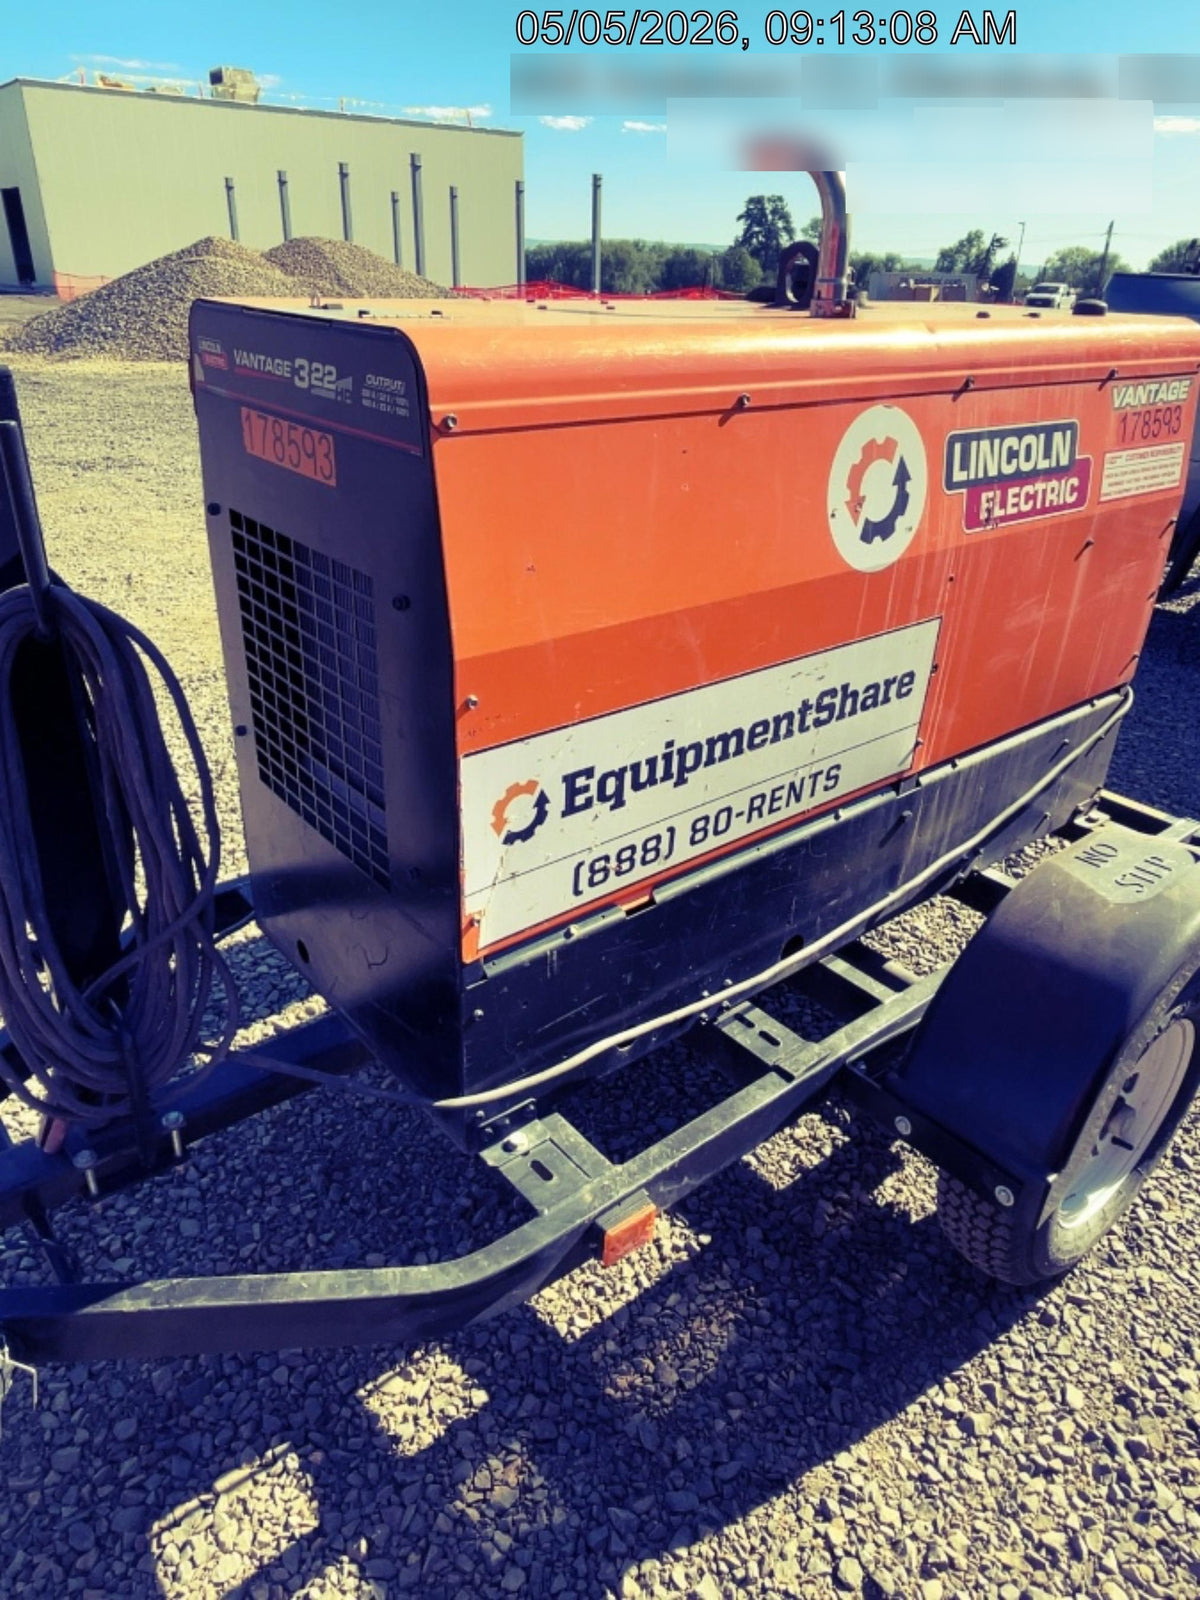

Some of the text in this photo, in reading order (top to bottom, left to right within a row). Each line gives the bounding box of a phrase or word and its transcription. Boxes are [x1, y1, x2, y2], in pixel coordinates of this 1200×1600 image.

[234, 350, 293, 377] VANTAGE
[294, 358, 337, 389] 322
[1112, 380, 1191, 408] VANTAGE
[1120, 405, 1182, 443] 178593
[244, 413, 333, 481] 178593
[952, 430, 1072, 482] LINCOLN
[979, 477, 1080, 520] ELECTRIC
[561, 669, 916, 818] EquipmentShare
[572, 764, 842, 897] (888) 80-RENTS
[1074, 843, 1118, 868] NO
